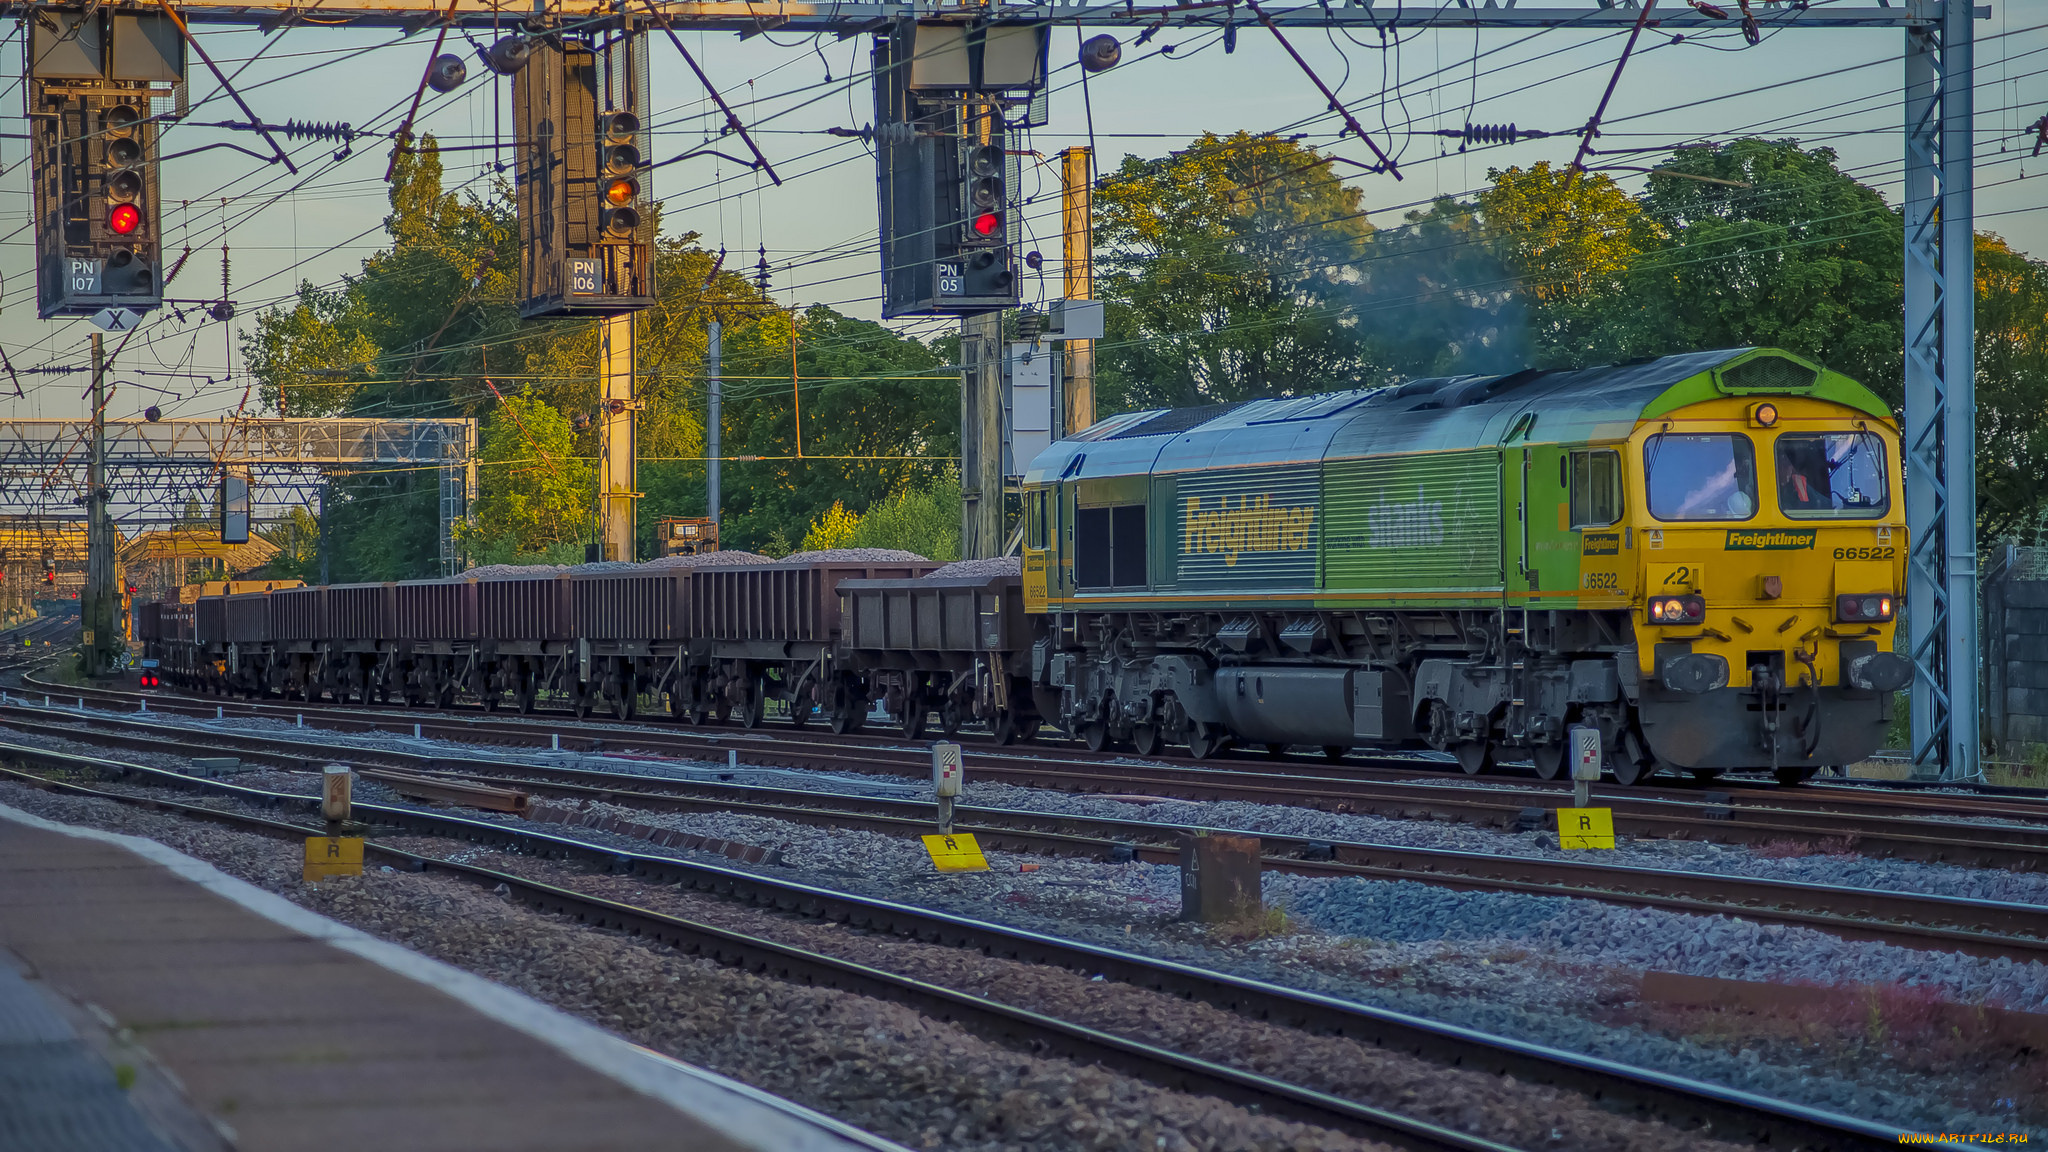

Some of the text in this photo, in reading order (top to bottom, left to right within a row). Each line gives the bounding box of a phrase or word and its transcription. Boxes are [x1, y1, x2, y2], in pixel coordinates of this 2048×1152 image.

[72, 261, 94, 274] PN
[574, 261, 594, 274] PN
[938, 264, 957, 277] PN
[72, 277, 94, 291] 107
[574, 276, 595, 290] 106
[107, 310, 126, 329] X
[1185, 493, 1315, 567] Freightliner
[1584, 537, 1619, 553] Freightliner
[1729, 532, 1813, 548] Freightliner
[1833, 547, 1896, 560] 66522
[1583, 572, 1617, 589] 66522
[1579, 815, 1591, 830] R
[327, 844, 339, 858] R
[944, 840, 958, 850] R
